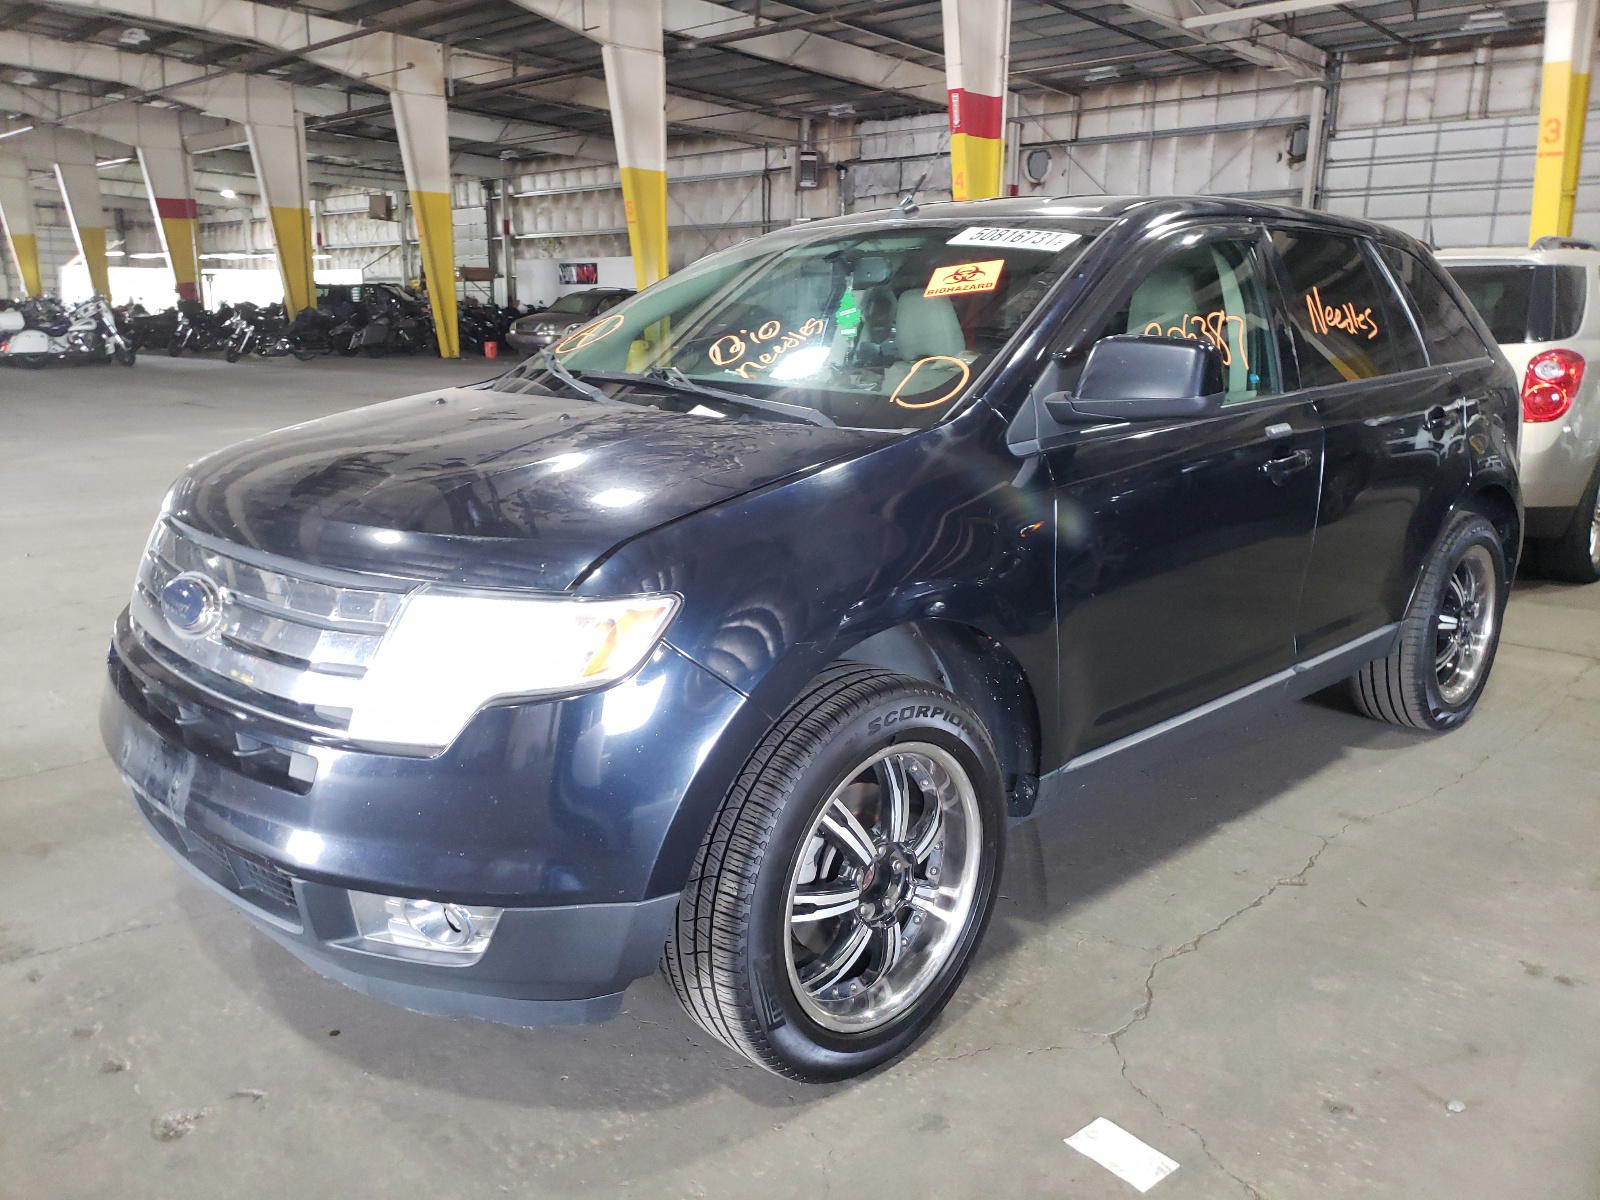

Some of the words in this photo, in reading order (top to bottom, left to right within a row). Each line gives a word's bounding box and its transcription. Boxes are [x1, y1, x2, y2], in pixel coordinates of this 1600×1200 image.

[1543, 118, 1562, 145] 3
[926, 282, 994, 296] BIOHAZARD
[1305, 286, 1378, 340] Needles
